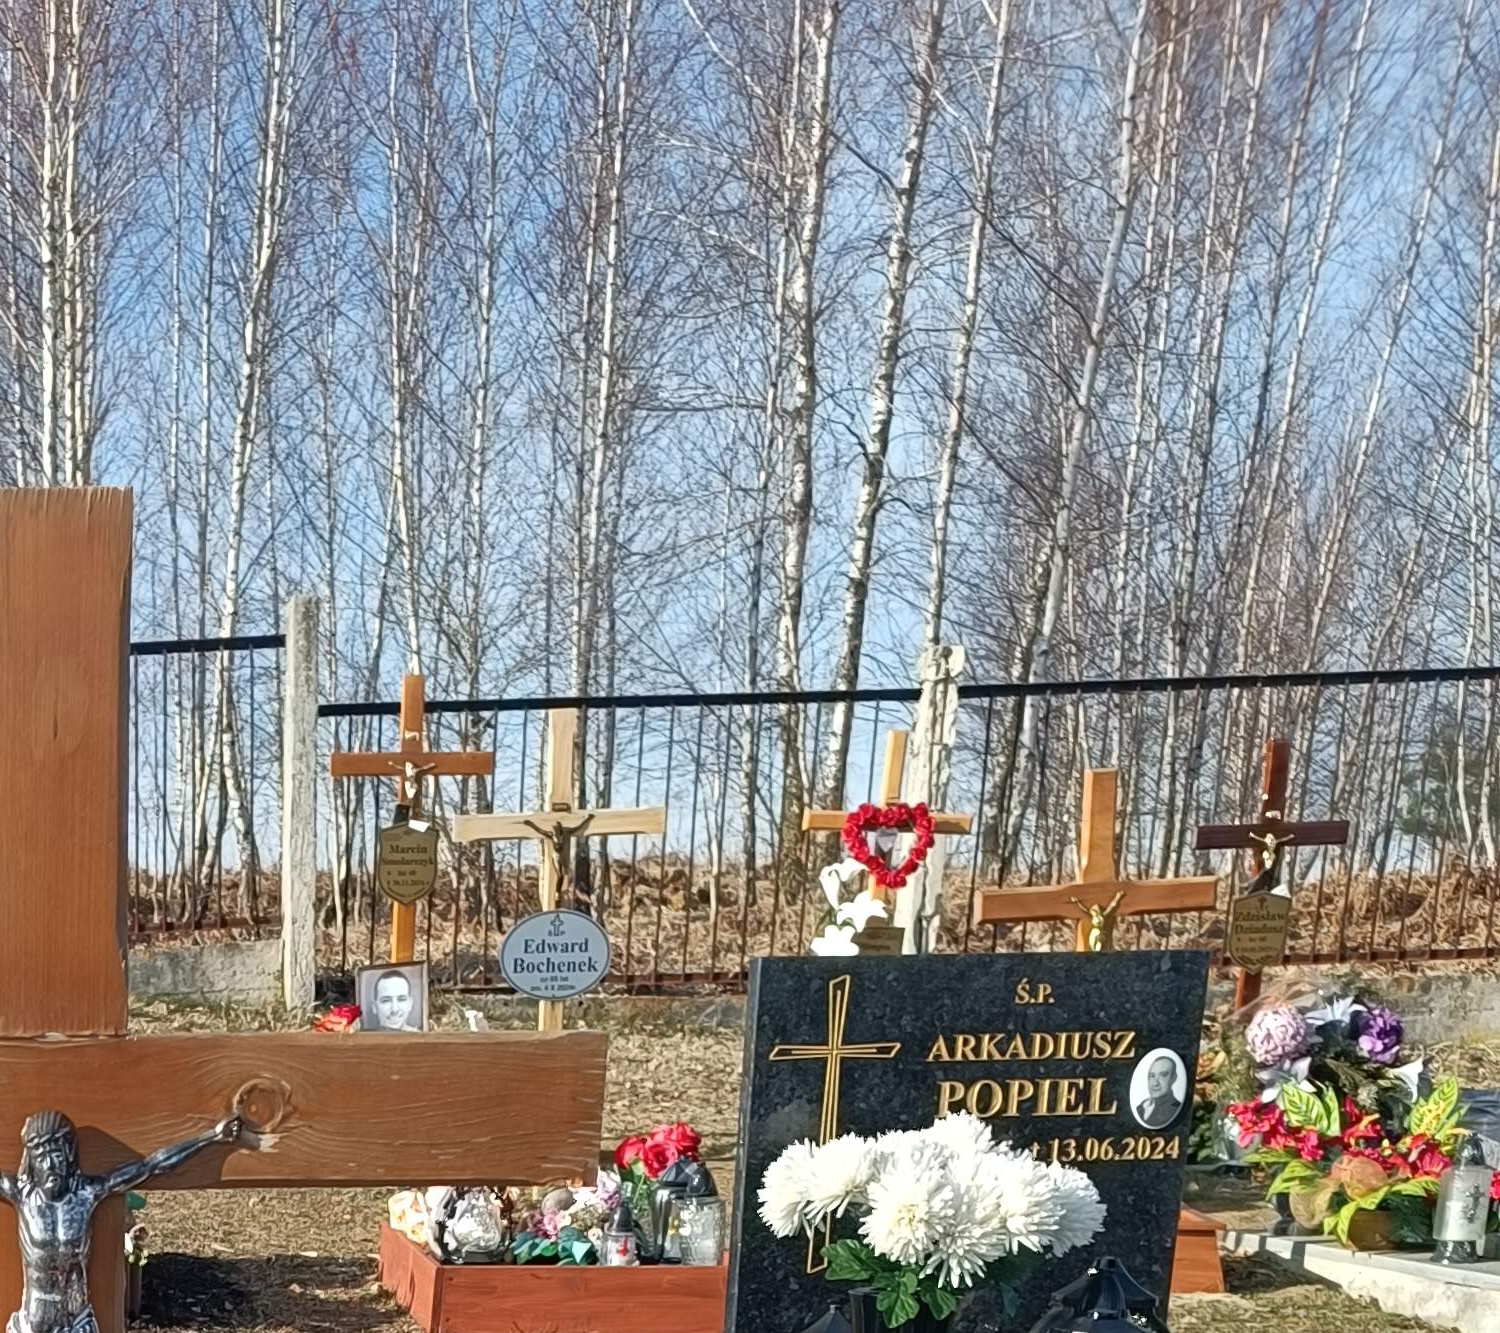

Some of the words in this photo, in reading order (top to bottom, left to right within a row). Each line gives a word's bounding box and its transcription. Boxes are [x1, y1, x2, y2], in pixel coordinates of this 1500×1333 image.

[388, 843, 428, 854] Marcin
[523, 937, 589, 954] Edward
[513, 956, 599, 974] Bochenek
[1014, 977, 1055, 1004] Ś.P.
[925, 1031, 1137, 1062] ARKADIUSZ
[934, 1077, 1118, 1119] POPIEL
[1048, 1135, 1181, 1164] 13.06.2024
